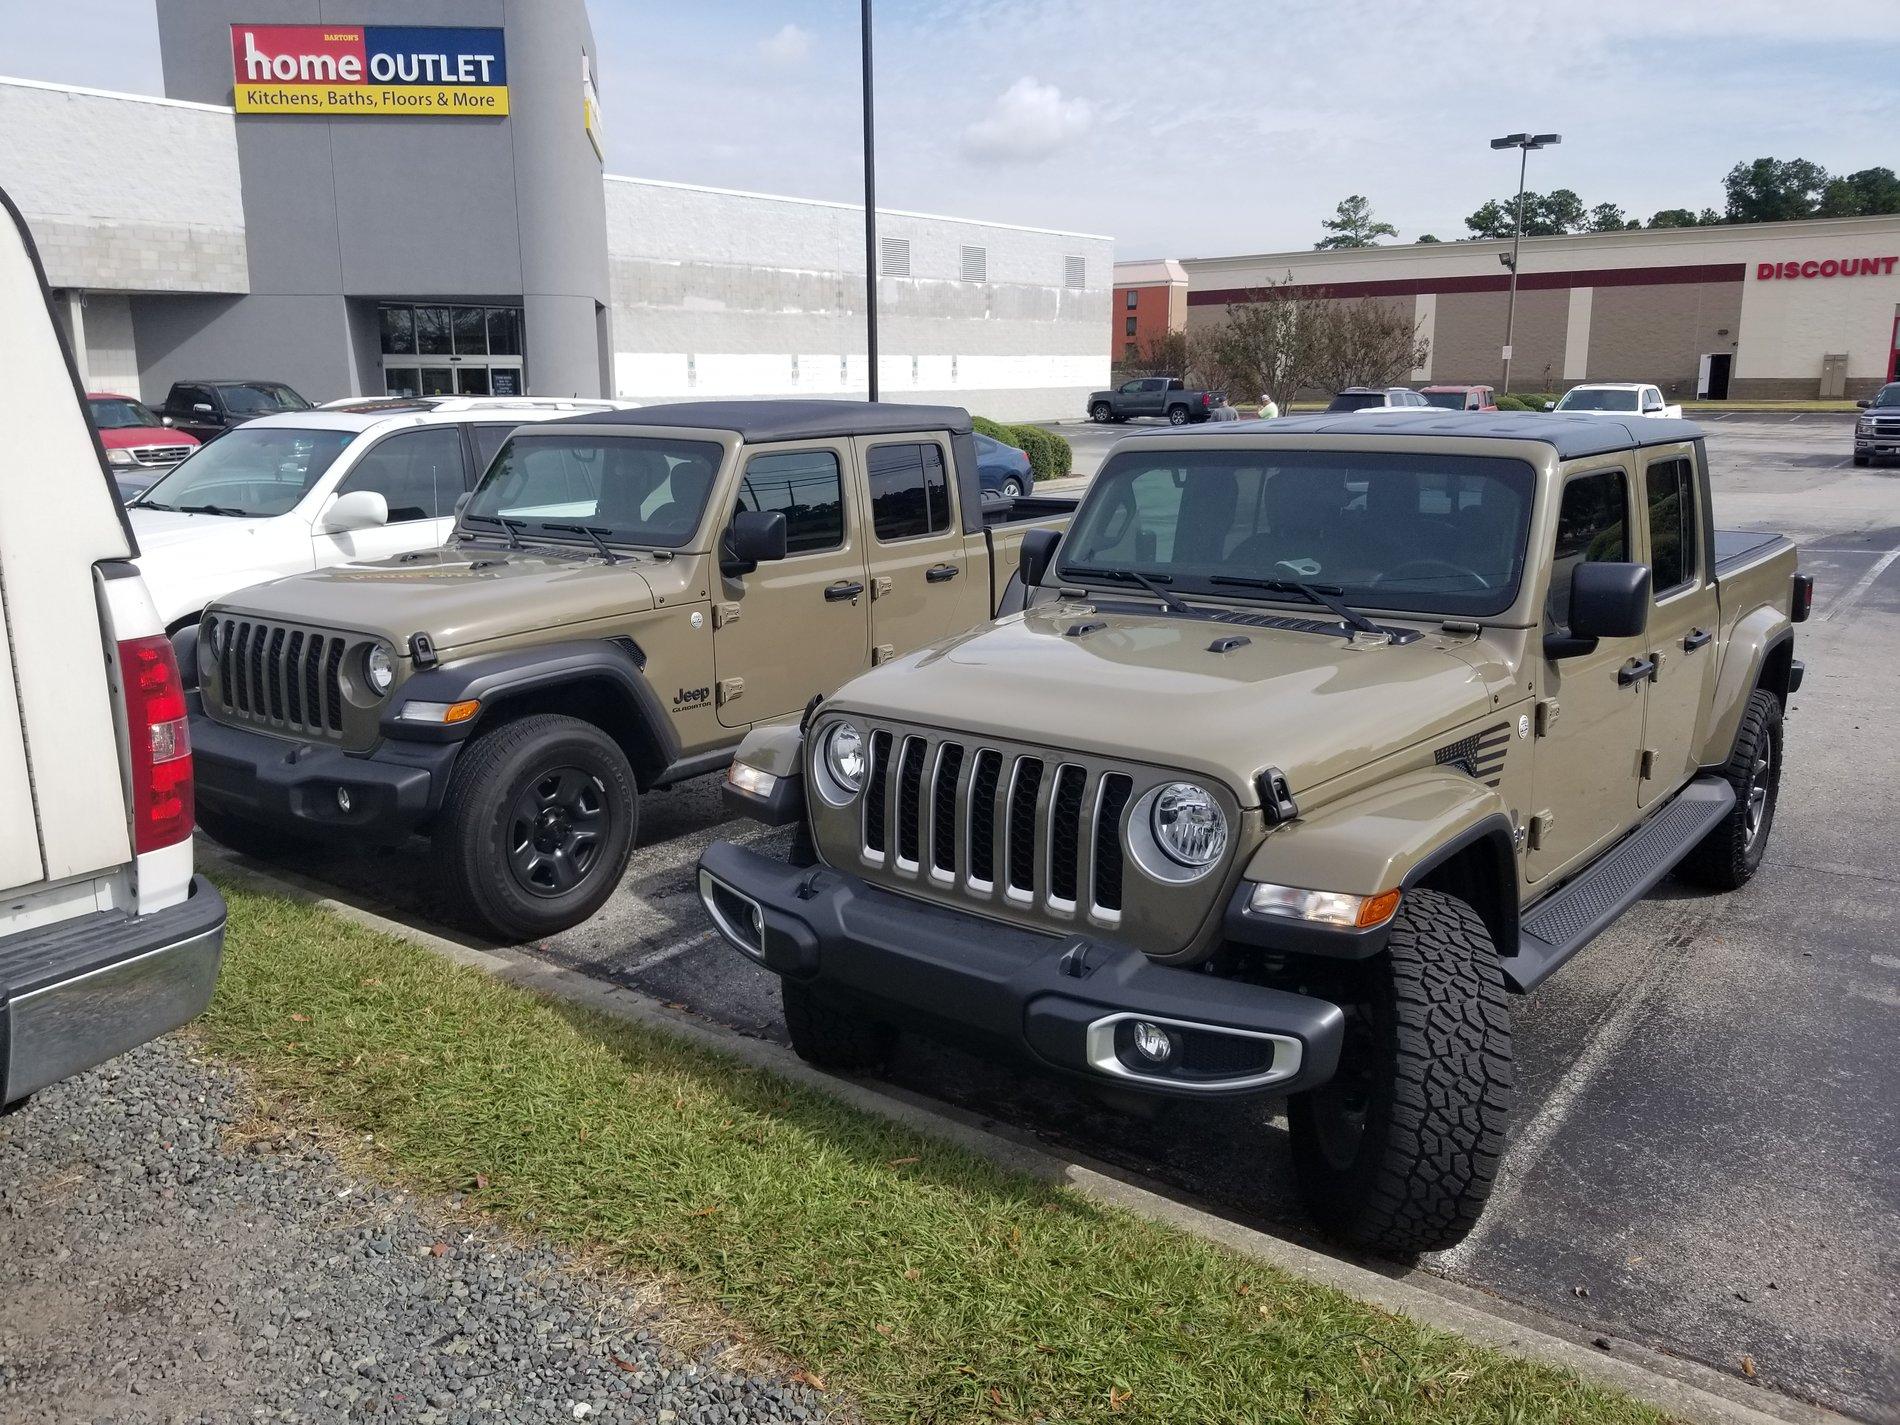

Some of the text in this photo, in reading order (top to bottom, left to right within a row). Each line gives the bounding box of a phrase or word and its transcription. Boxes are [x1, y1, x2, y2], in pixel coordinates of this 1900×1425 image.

[245, 32, 495, 82] home OUTLET
[247, 90, 495, 108] Kitchens, Baths, Floors & More
[1757, 256, 1899, 280] DISCOUNT
[673, 687, 710, 704] Jeep
[672, 701, 712, 713] GLADIATOR
